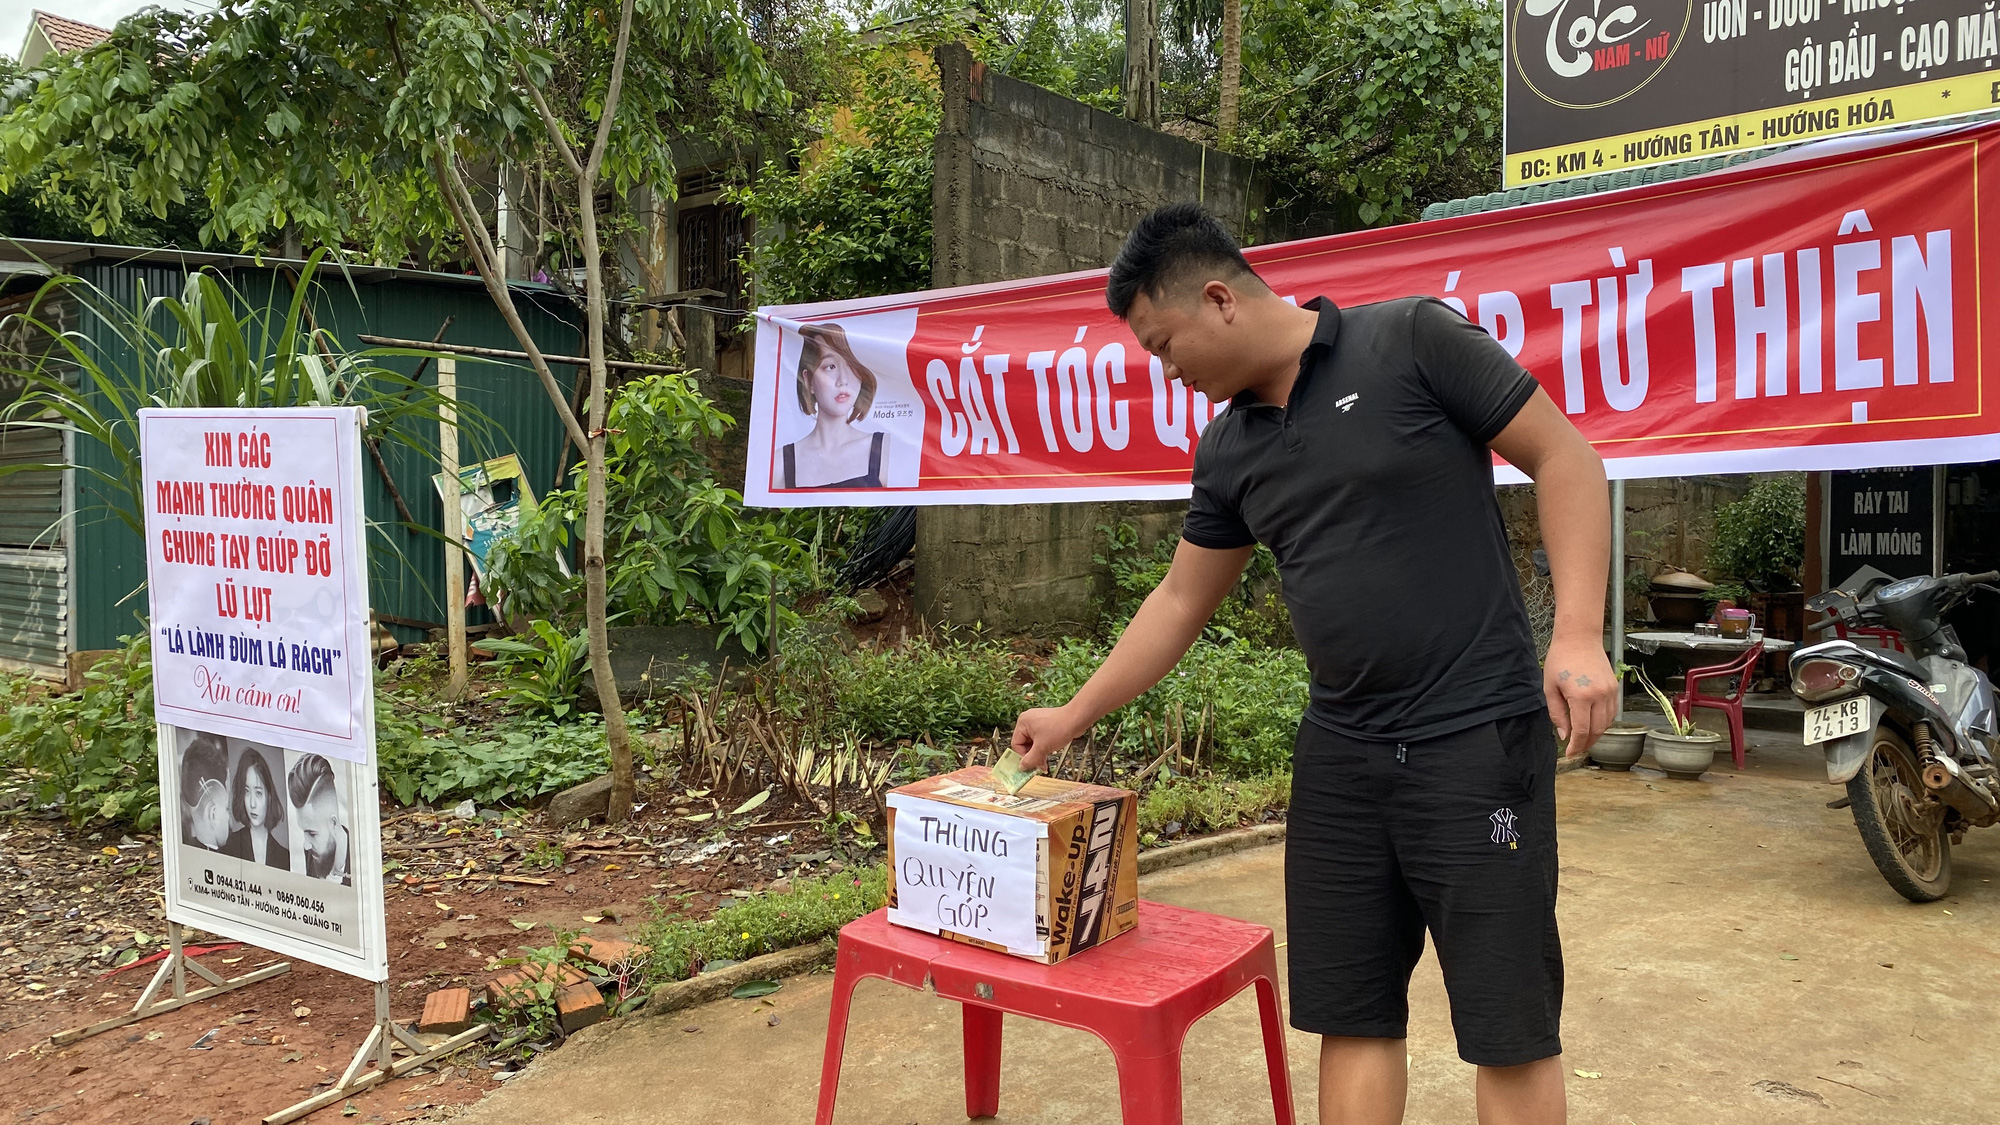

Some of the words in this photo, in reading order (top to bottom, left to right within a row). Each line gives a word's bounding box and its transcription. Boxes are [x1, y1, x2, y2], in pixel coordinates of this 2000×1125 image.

[1594, 43, 1630, 71] NAM
[1645, 30, 1670, 61] NỮ
[1785, 37, 1822, 98] GỘI
[1828, 22, 1876, 85] ĐẦU
[1900, 20, 1949, 78] CẠO
[1521, 158, 1550, 179] ĐC:
[1556, 152, 1586, 174] KM
[1592, 149, 1604, 167] 4
[1624, 134, 1692, 163] HƯỚNG
[1699, 124, 1740, 150] TÂN
[1762, 108, 1839, 139] HƯỚNG
[1847, 97, 1895, 126] HÓA
[925, 325, 1020, 457] CẮT
[1027, 325, 1130, 453] TÓC
[1551, 246, 1653, 414] TỪ
[1682, 209, 1954, 424] THIỆN
[873, 410, 895, 419] Mods
[204, 432, 232, 467] XIN
[238, 425, 271, 468] CÁC
[156, 480, 205, 522] MẠNH
[210, 477, 276, 521] THƯỜNG
[282, 479, 333, 524] QUÂN
[1854, 487, 1883, 514] RÁY
[1887, 491, 1908, 514] TAI
[162, 529, 215, 566] CHUNG
[221, 533, 249, 569] TAY
[256, 530, 298, 574] GIÚP
[305, 533, 331, 577] ĐỠ
[1841, 528, 1871, 555] LÀM
[1876, 528, 1921, 555] MÓNG
[216, 577, 237, 618] LŨ
[243, 585, 272, 629] LỤT
[188, 626, 224, 660] LÀNH
[229, 632, 263, 665] ĐÙM
[268, 637, 286, 669] LÁ
[194, 664, 230, 704] Xin
[236, 683, 272, 708] cám
[1814, 701, 1858, 725] 74-K8
[1814, 717, 1858, 740] 2413
[919, 814, 1007, 857] THÙNG
[217, 874, 262, 896] 0944.821.444
[276, 890, 325, 913] 0869.060.456
[903, 857, 995, 899] QUYÊN
[255, 900, 280, 915] HƯỚNG
[281, 907, 297, 921] HÓA
